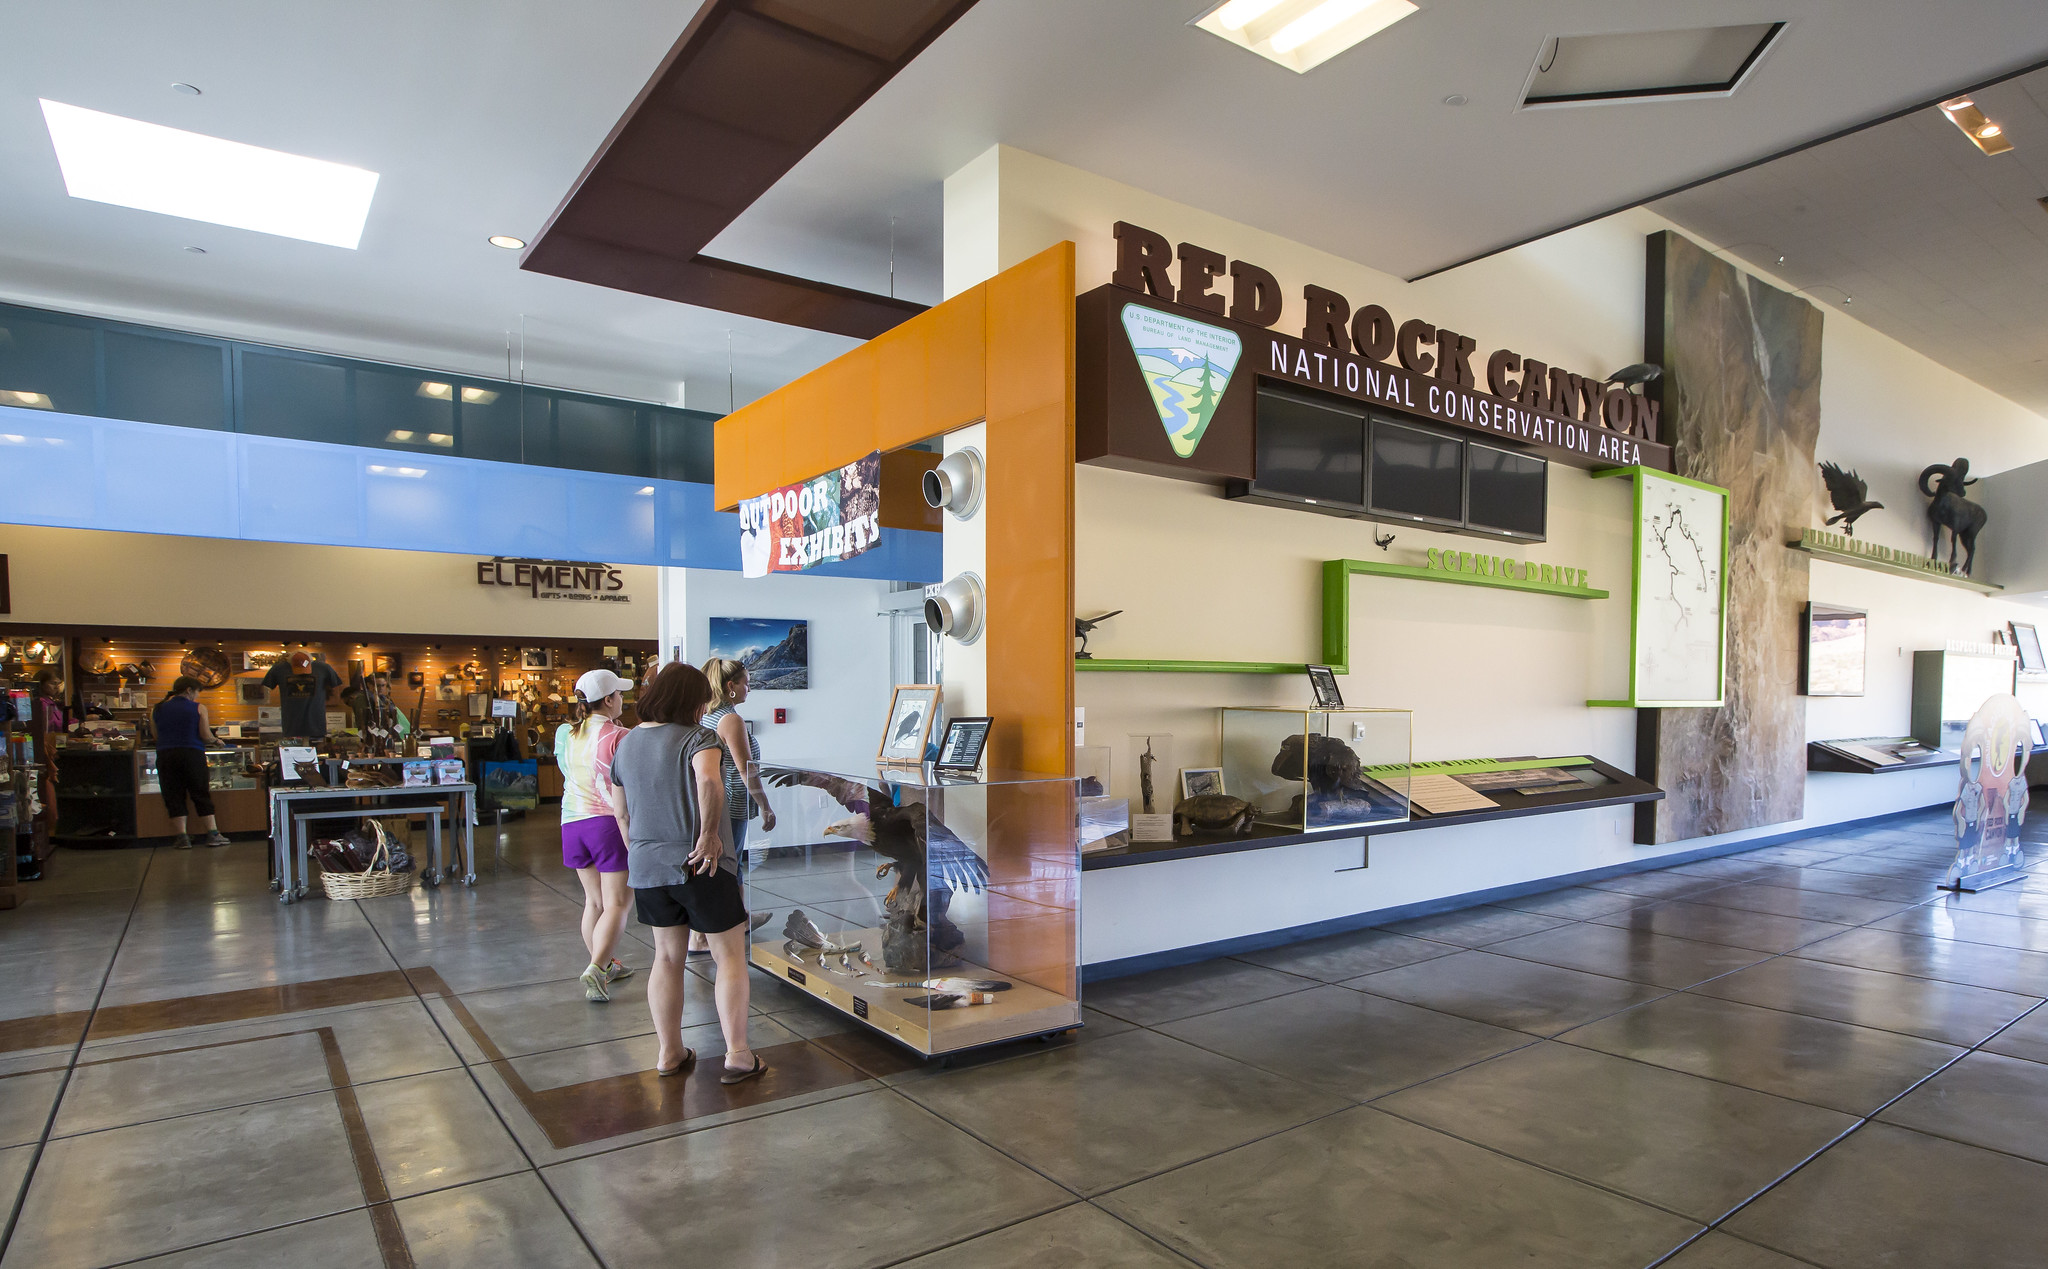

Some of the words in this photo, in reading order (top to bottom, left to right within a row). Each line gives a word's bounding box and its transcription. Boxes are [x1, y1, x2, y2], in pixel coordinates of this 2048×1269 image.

[1112, 220, 1283, 328] RED
[1302, 283, 1476, 390] ROCK
[1487, 349, 1660, 443] CANYON
[1142, 325, 1165, 336] BUREAU
[1177, 335, 1192, 343] LAND
[1195, 338, 1229, 352] MANAGEMENT
[1143, 315, 1185, 331] DEPARTMENT
[1186, 326, 1195, 334] OF
[1196, 329, 1208, 338] THE
[1209, 333, 1236, 346] INTERIOR
[1271, 340, 1415, 407] NATIONAL
[1428, 385, 1590, 453] CONSERVATION
[1598, 433, 1641, 465] AREA
[739, 480, 829, 531] OUTDOOR
[778, 509, 880, 565] EXHIBITS
[1802, 527, 1845, 550] BUREAU
[1865, 541, 1890, 560] LAND
[477, 561, 624, 599] ELEMENTS
[1427, 547, 1516, 579] SCENIC
[1525, 560, 1588, 589] DRIVE
[540, 592, 561, 600] GIFTS
[568, 592, 592, 601] BOOKS
[600, 594, 631, 603] APPAREL
